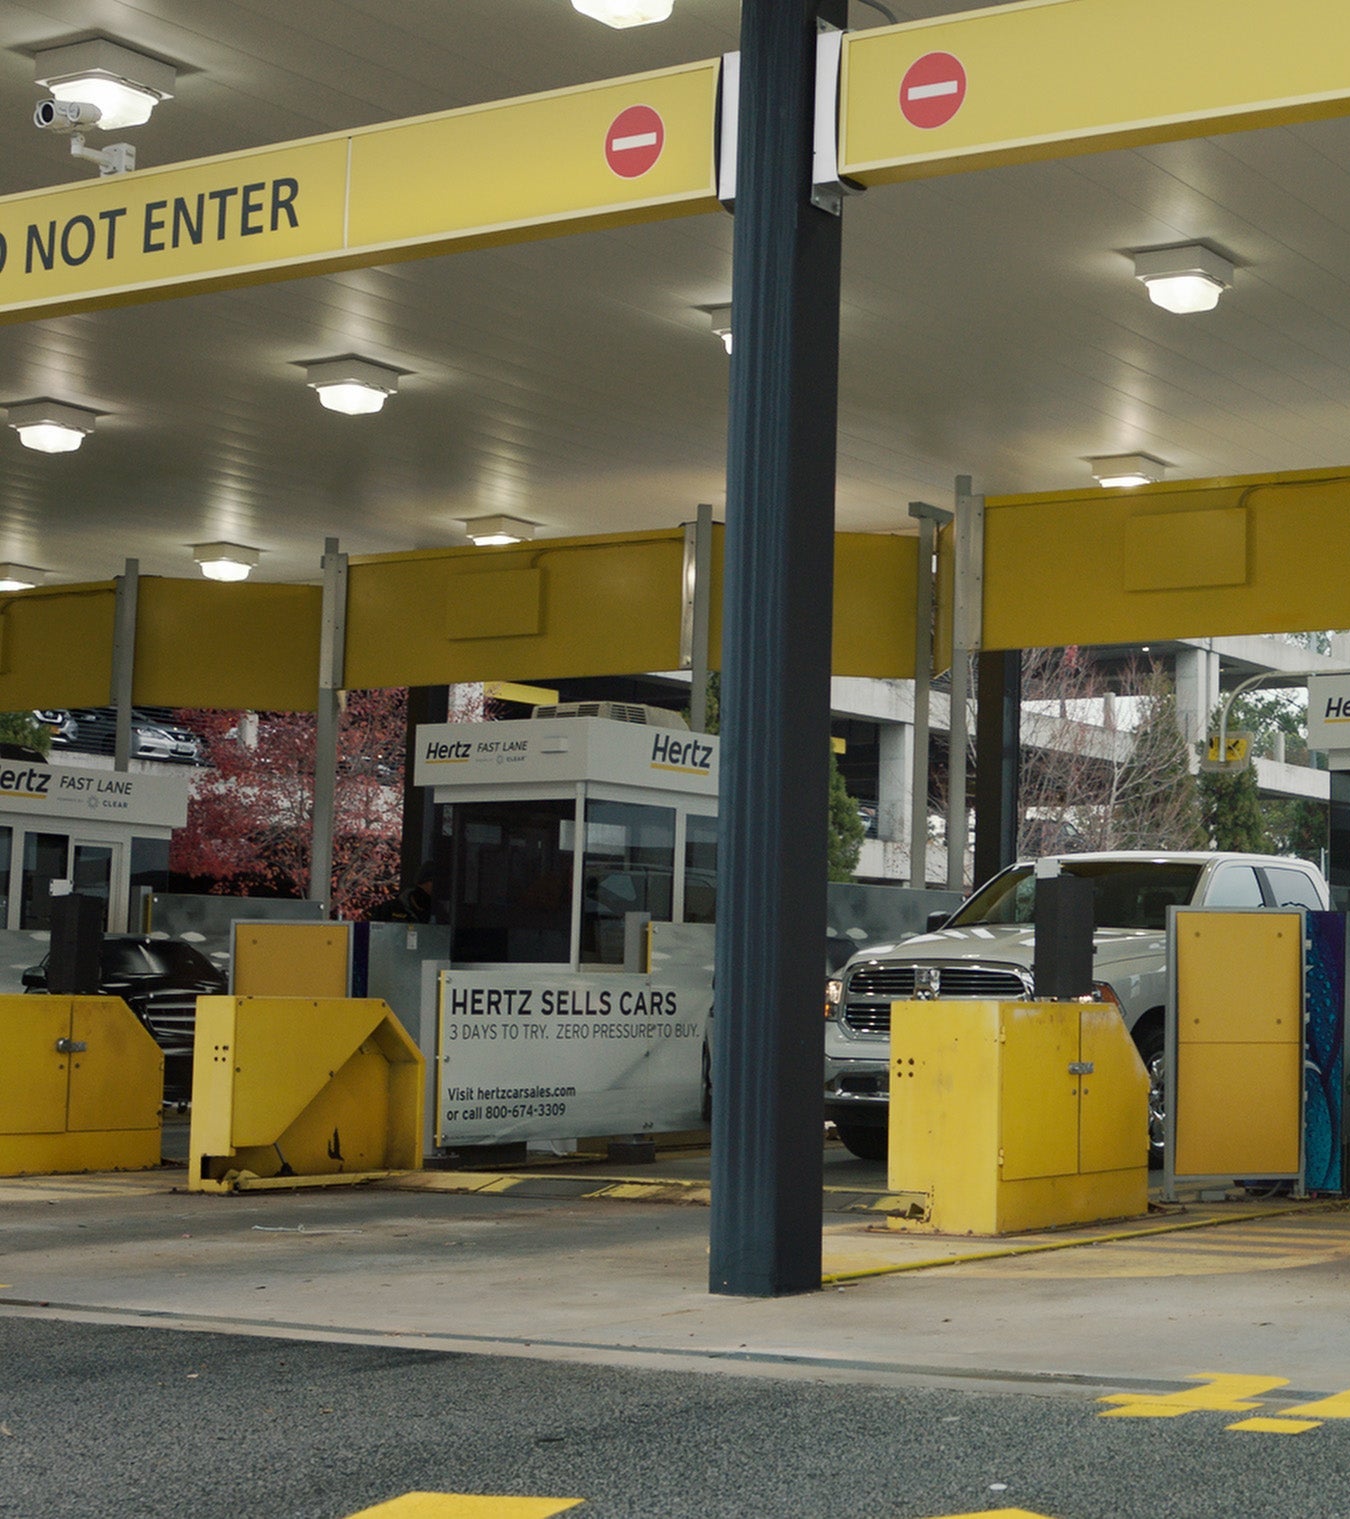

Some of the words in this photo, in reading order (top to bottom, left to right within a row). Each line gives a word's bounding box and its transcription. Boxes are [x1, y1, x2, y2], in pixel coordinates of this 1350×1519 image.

[25, 207, 127, 274] NOT
[143, 177, 300, 254] ENTER
[426, 741, 472, 760] Hertz
[477, 742, 500, 752] FAST
[502, 740, 528, 751] LANE
[652, 733, 713, 769] Hertz
[0, 766, 52, 793] ertz
[60, 775, 94, 791] FAST
[97, 780, 133, 795] LANE
[102, 799, 129, 809] CLEAR
[452, 989, 533, 1016] HERTZ
[541, 989, 612, 1016] SELLS
[619, 991, 678, 1016] CARS
[450, 1025, 458, 1040] 3
[462, 1024, 497, 1040] DAYS
[501, 1024, 519, 1040] TO
[523, 1024, 550, 1040] TRY.
[556, 1023, 589, 1040] ZERO
[593, 1023, 652, 1039] PRESSURE
[655, 1023, 671, 1039] TO
[675, 1023, 700, 1039] BUY.
[448, 1087, 473, 1101] Visit
[477, 1085, 576, 1100] hertzcarsales.com
[447, 1110, 459, 1121] or
[462, 1107, 482, 1120] call
[486, 1103, 566, 1119] 800-674-3309
